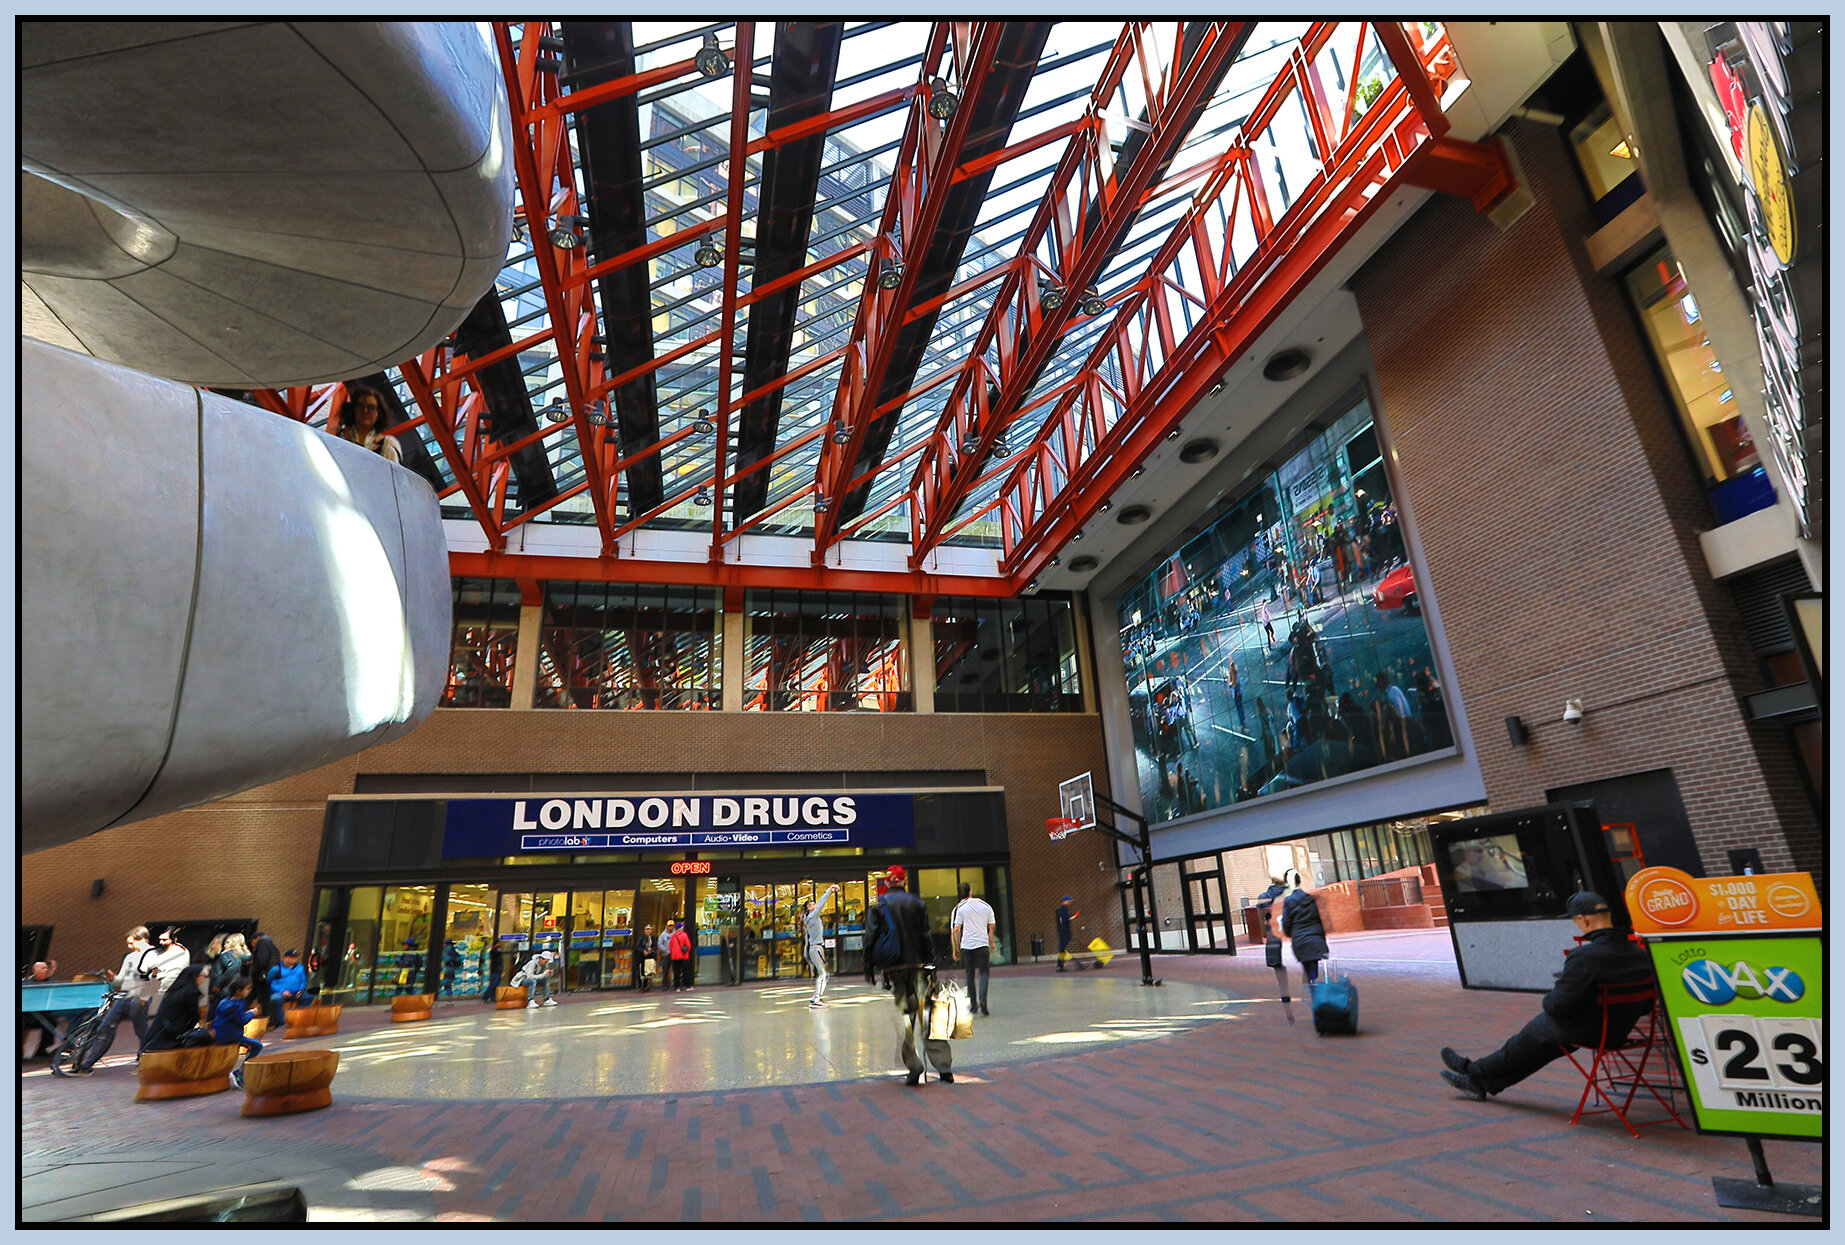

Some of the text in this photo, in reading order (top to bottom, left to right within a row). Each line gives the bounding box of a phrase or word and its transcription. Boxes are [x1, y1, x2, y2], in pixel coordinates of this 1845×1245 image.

[512, 796, 857, 831] LONDON DRUGS
[538, 835, 581, 847] photolab
[622, 834, 678, 845] Computers
[786, 830, 833, 841] Cosmetics
[670, 862, 711, 875] OPEN
[1646, 891, 1690, 913] GRAND
[1727, 896, 1757, 910] DAY
[1733, 909, 1769, 924] LIFE
[1682, 959, 1800, 1004] MAX
[1690, 1029, 1822, 1085] $ 23
[1734, 1091, 1822, 1111] Million
